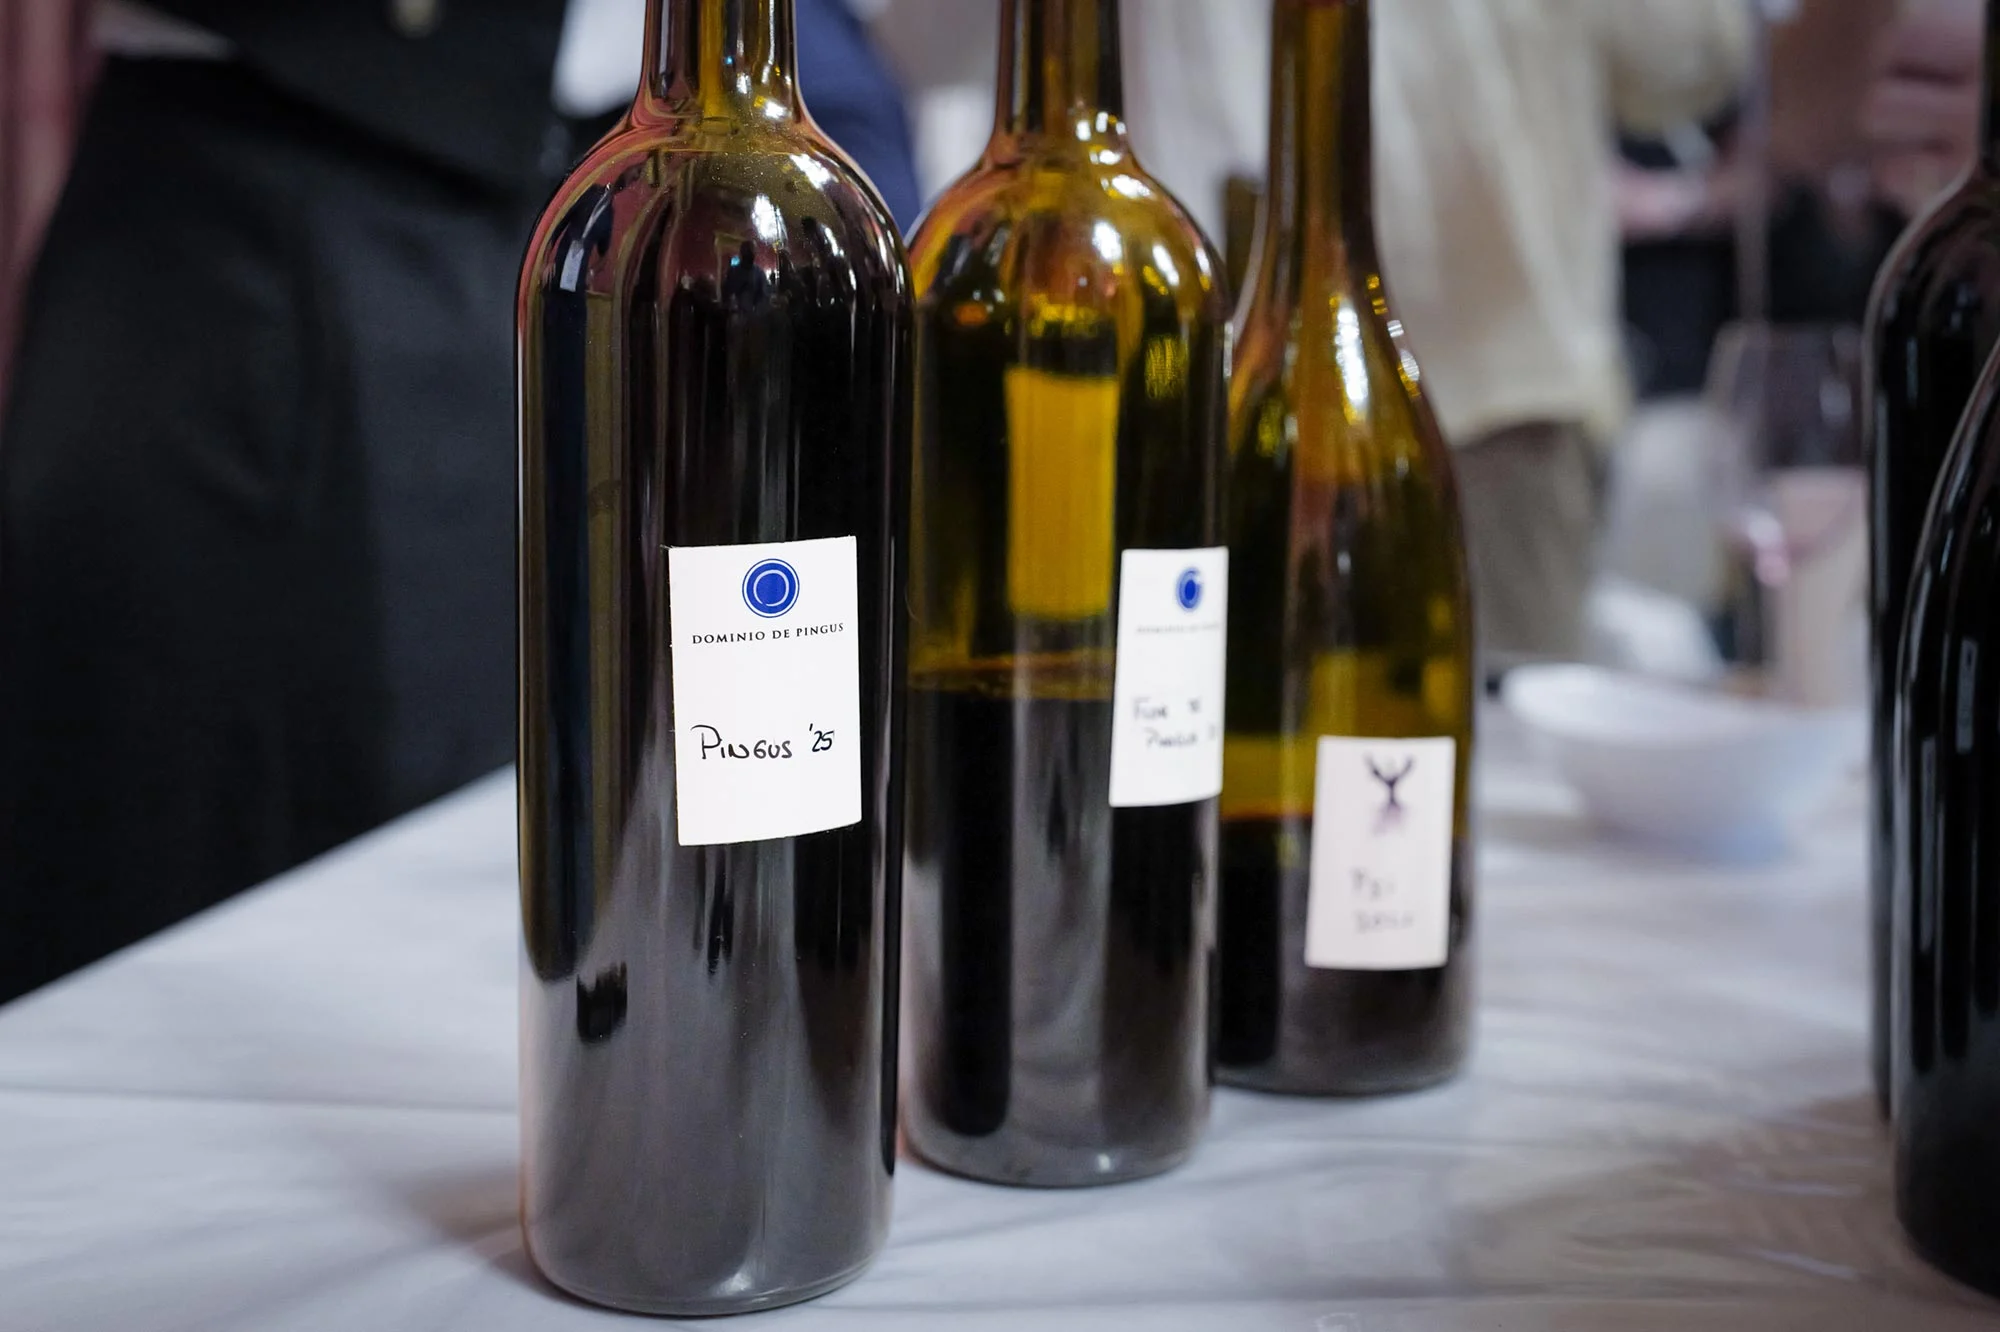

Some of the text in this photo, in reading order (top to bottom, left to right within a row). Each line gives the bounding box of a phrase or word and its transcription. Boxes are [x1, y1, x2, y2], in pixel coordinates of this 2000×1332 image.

[692, 622, 844, 645] DOMINIO DE PINGUS
[808, 722, 835, 753] '25
